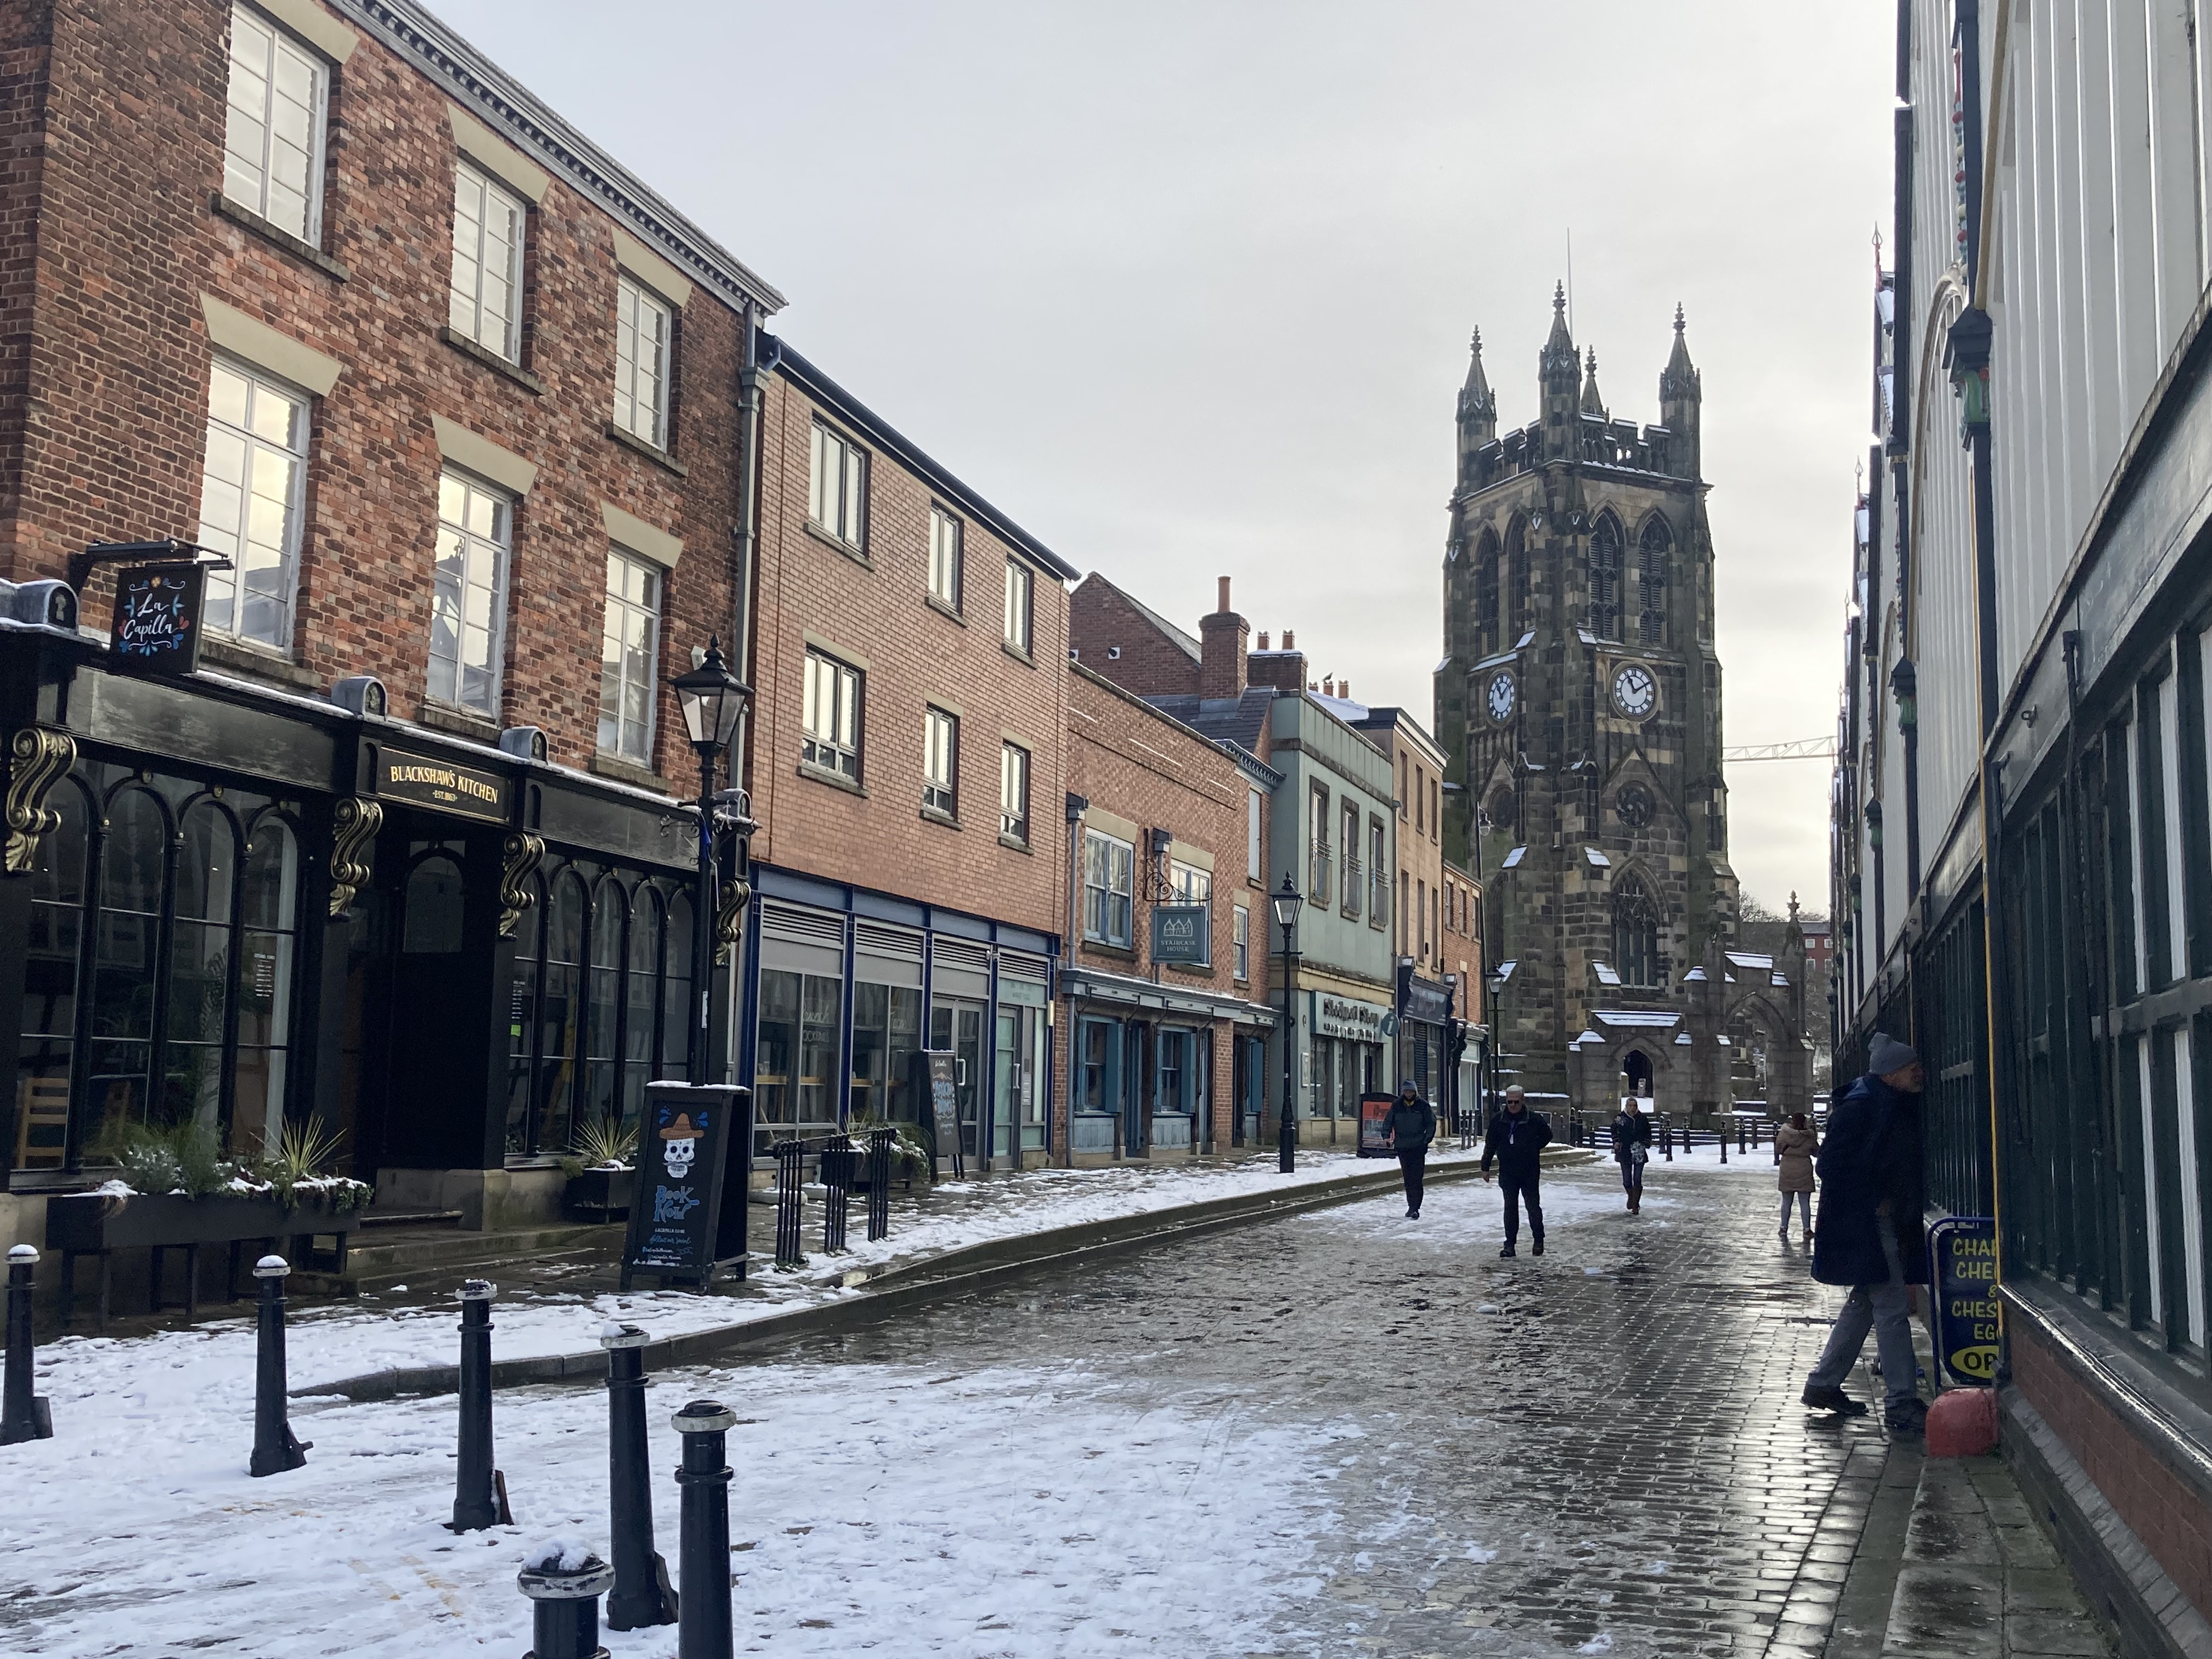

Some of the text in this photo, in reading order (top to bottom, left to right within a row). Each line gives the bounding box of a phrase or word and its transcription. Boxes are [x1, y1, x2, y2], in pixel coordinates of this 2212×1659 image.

[137, 593, 170, 617] La
[123, 614, 178, 642] Capilla
[390, 766, 498, 804] BLACKSHAW'S KITCHEN
[1952, 1238, 1996, 1256] CHA
[1956, 1261, 1996, 1280] CHE
[1951, 1301, 1997, 1318] CHES
[1974, 1323, 1999, 1340] EG
[1963, 1352, 1997, 1371] OP
